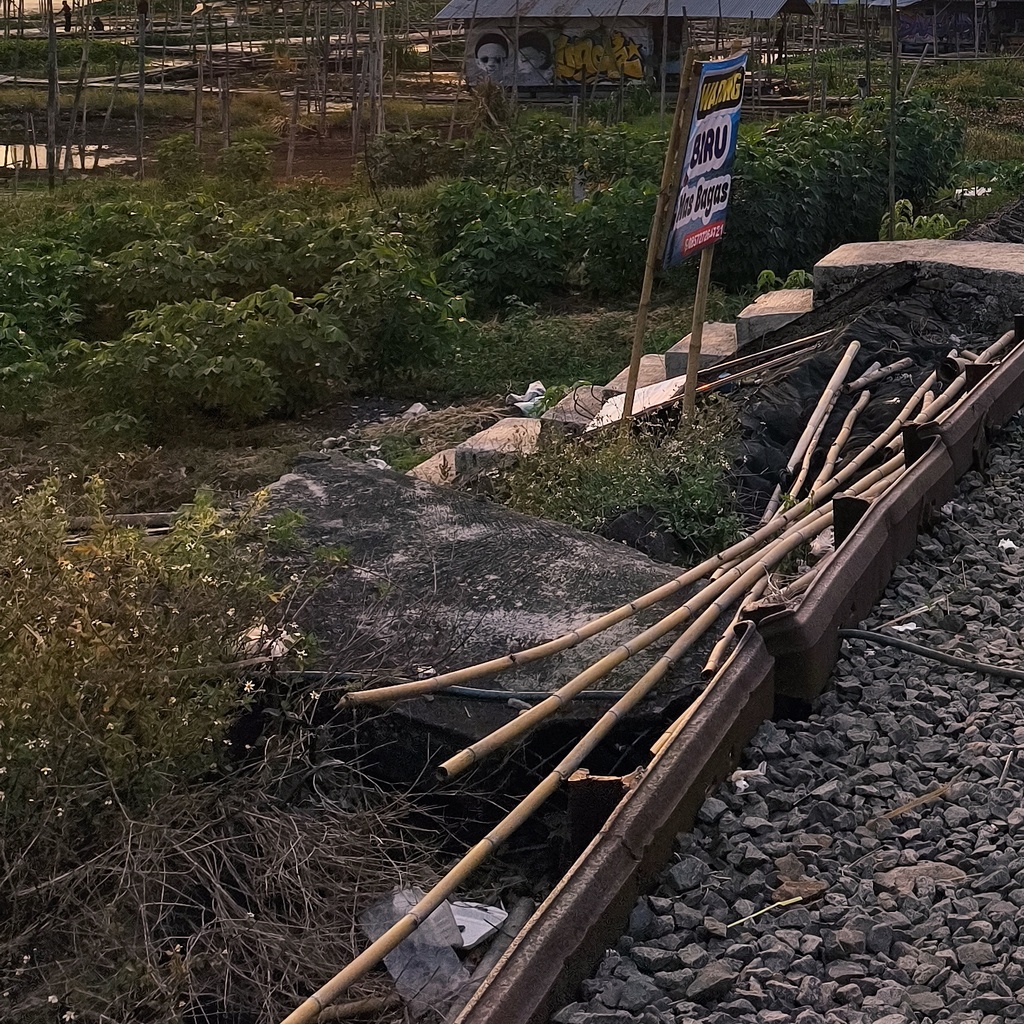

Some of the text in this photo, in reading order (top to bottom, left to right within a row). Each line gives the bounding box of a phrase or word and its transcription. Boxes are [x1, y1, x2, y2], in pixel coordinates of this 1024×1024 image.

[690, 125, 728, 169] BIRU
[676, 181, 729, 223] Mas Bagas
